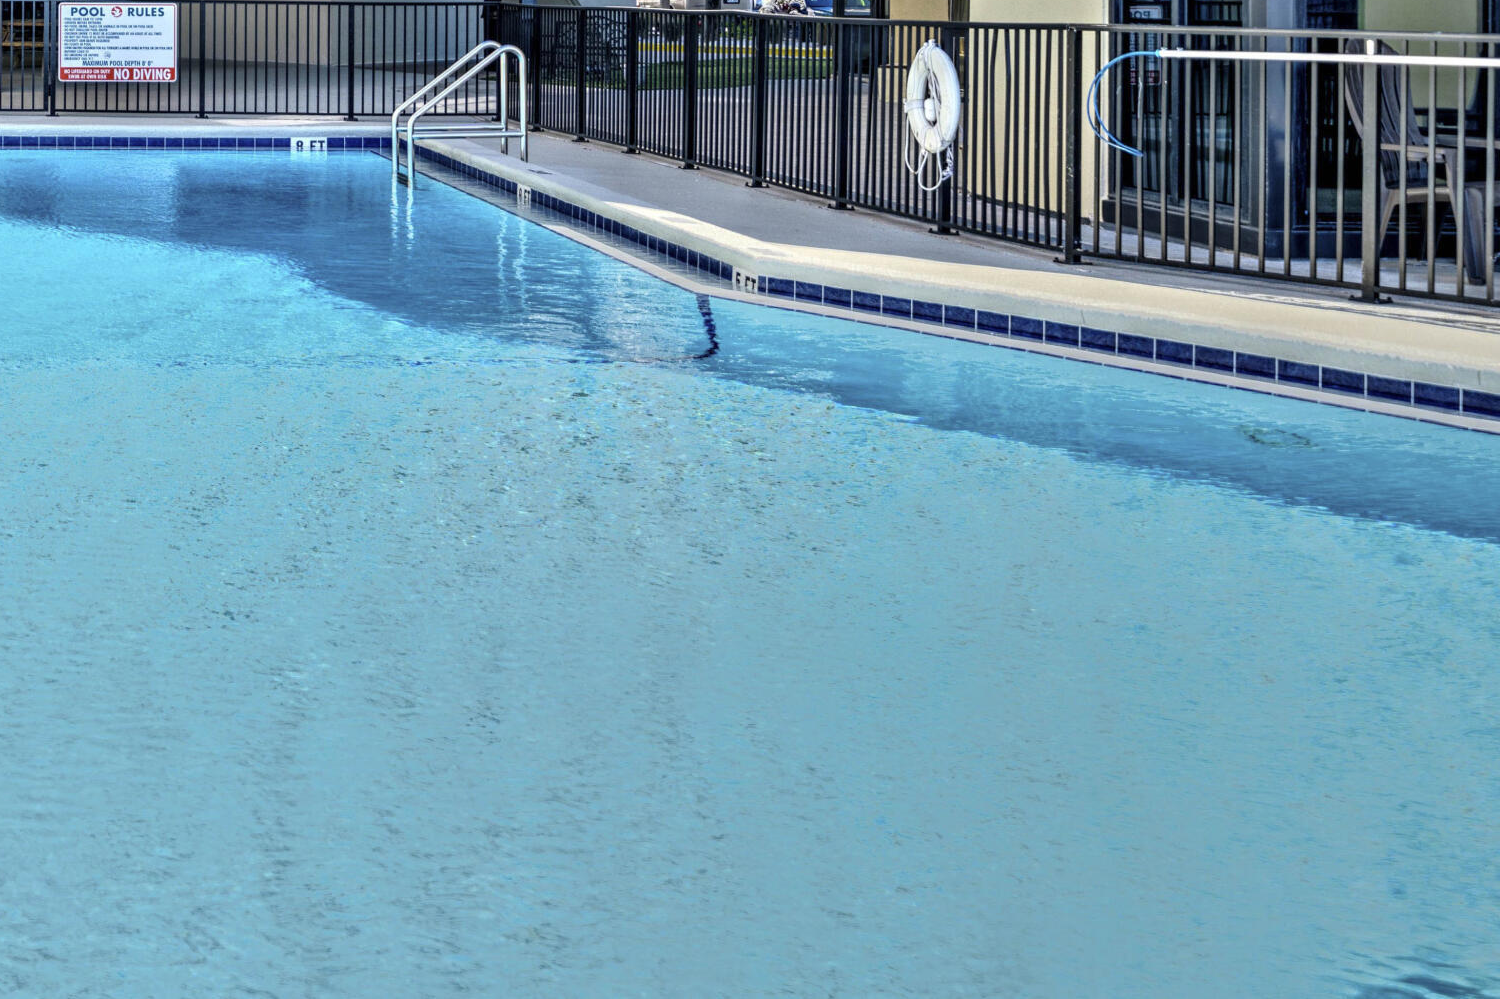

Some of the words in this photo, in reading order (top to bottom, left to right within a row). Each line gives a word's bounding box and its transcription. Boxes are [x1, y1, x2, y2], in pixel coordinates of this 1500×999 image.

[70, 7, 105, 17] POOL
[127, 7, 165, 17] RULES
[113, 68, 130, 80] NO
[133, 68, 172, 80] DIVING
[310, 140, 325, 151] FT
